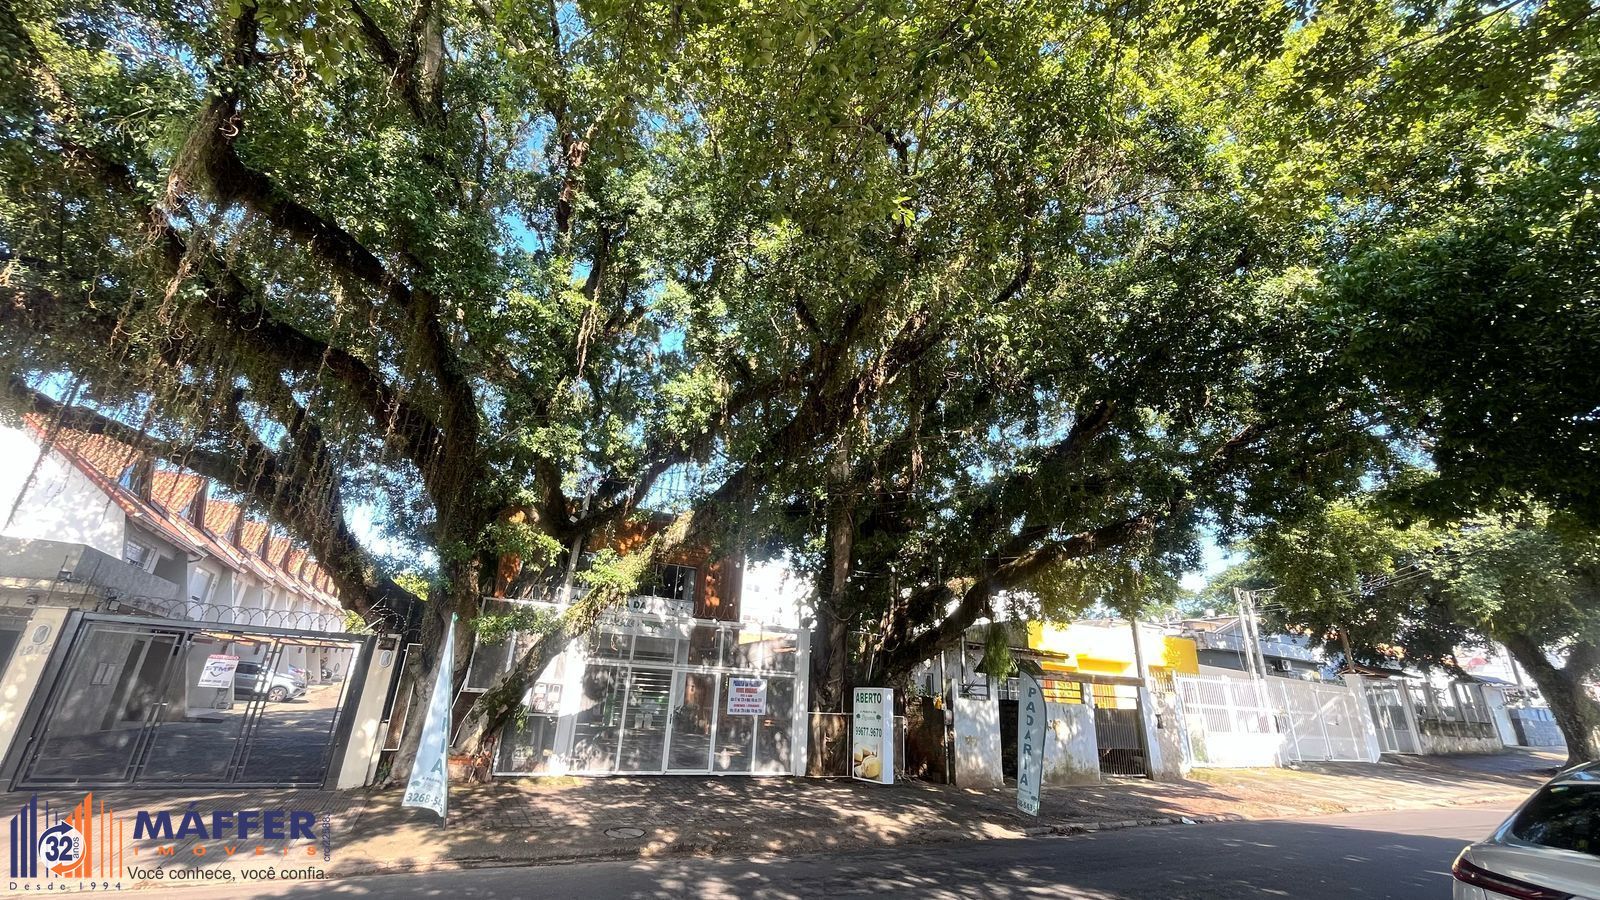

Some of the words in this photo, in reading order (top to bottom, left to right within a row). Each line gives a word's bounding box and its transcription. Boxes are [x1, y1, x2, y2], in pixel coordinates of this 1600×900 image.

[855, 692, 882, 704] ABERTO
[855, 726, 883, 738] 99677.9670
[1019, 687, 1037, 786] PADARIA
